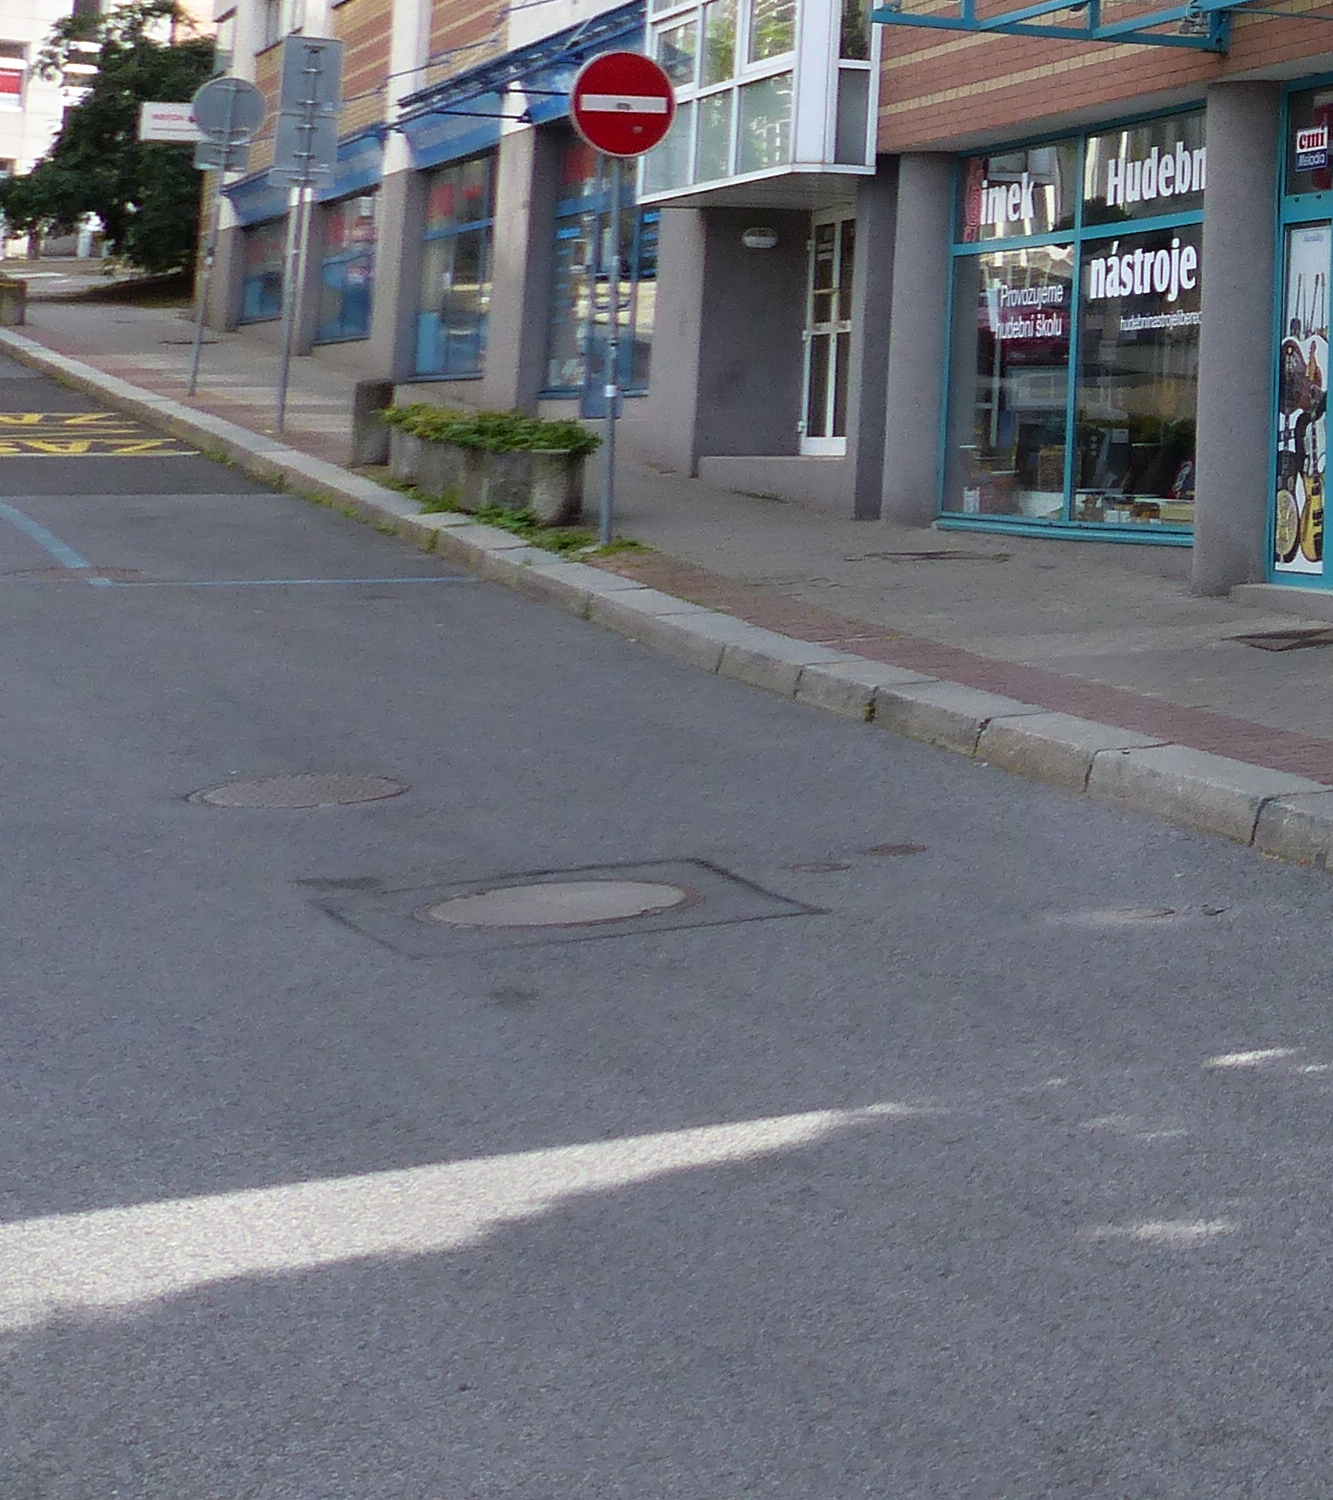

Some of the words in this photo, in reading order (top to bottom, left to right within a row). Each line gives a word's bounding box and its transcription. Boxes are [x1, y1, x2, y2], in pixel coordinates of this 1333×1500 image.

[1106, 141, 1207, 206] Hudebn
[1000, 283, 1064, 311] Provozujeme
[1089, 238, 1198, 302] nástroje
